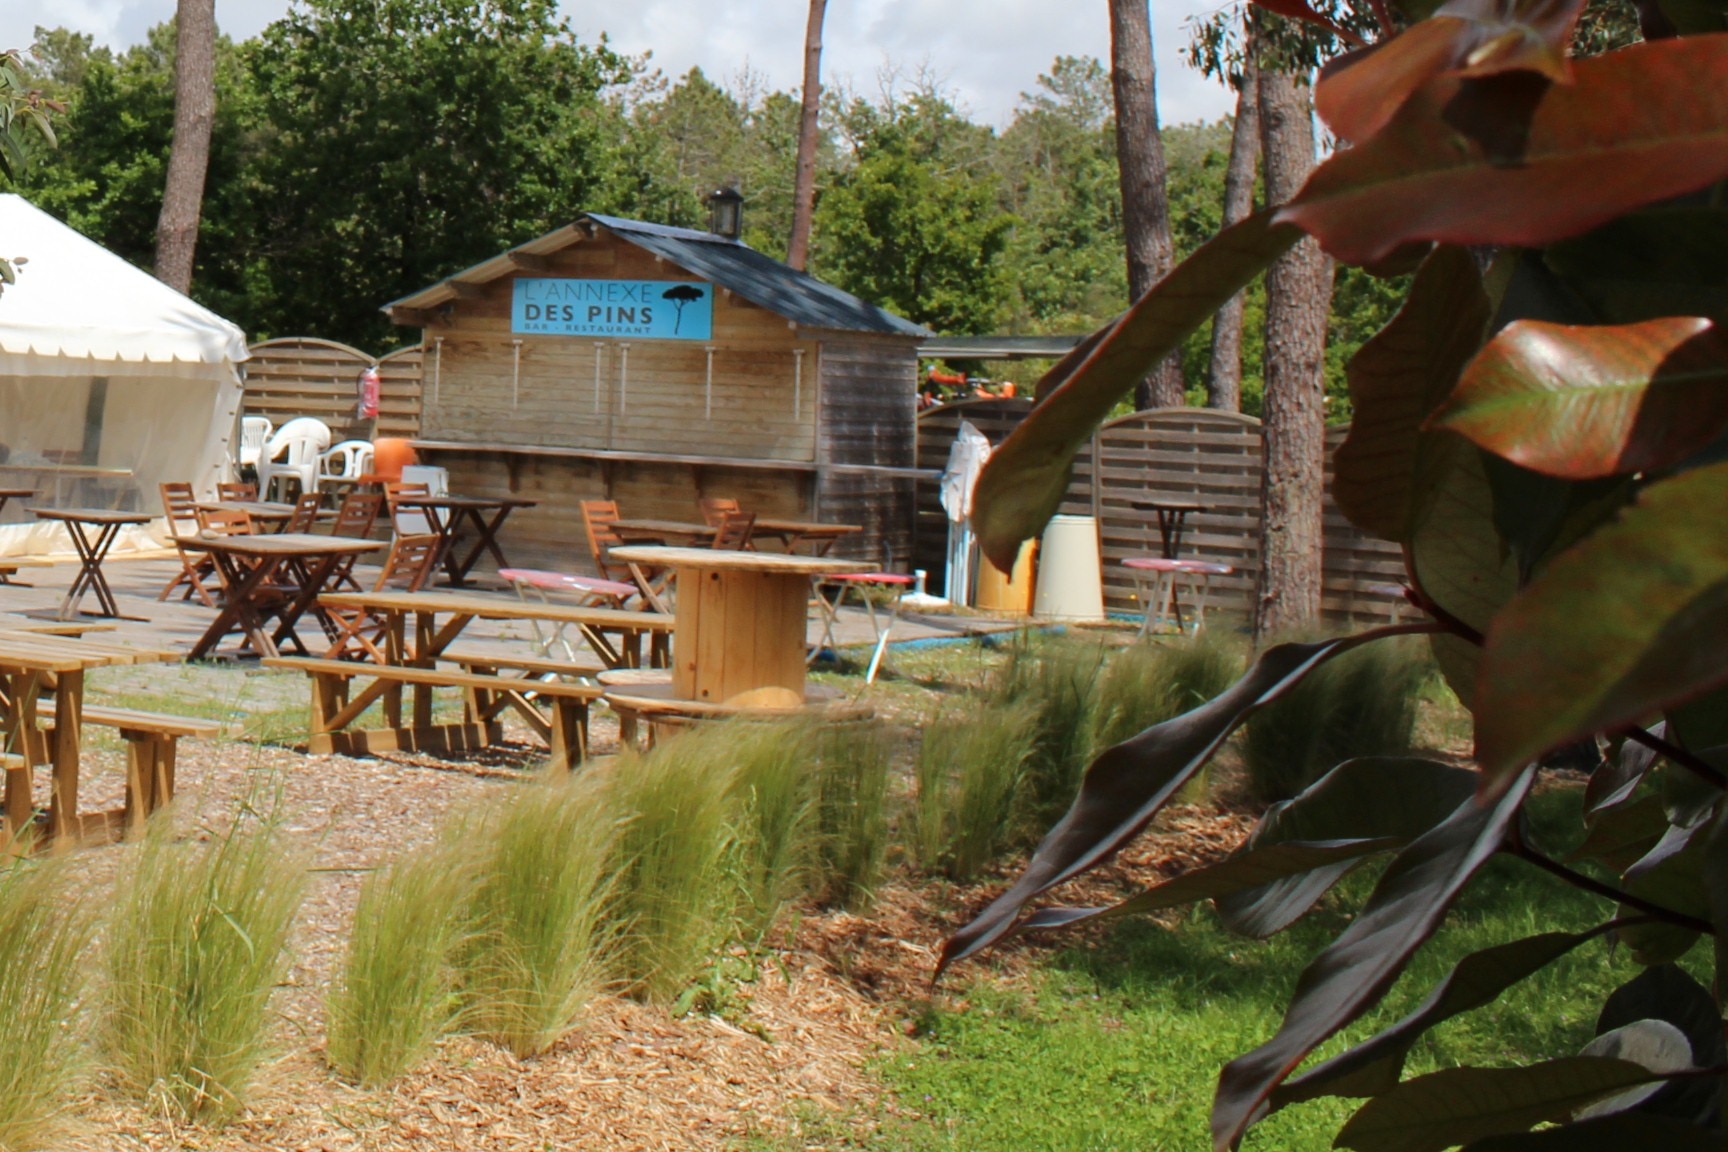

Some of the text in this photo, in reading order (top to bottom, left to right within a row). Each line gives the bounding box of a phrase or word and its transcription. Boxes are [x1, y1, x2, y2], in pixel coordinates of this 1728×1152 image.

[524, 281, 653, 303] L'ANNEXE
[525, 304, 653, 324] DES PINS
[524, 323, 548, 331] BAR
[565, 324, 652, 334] RESTAURANT
